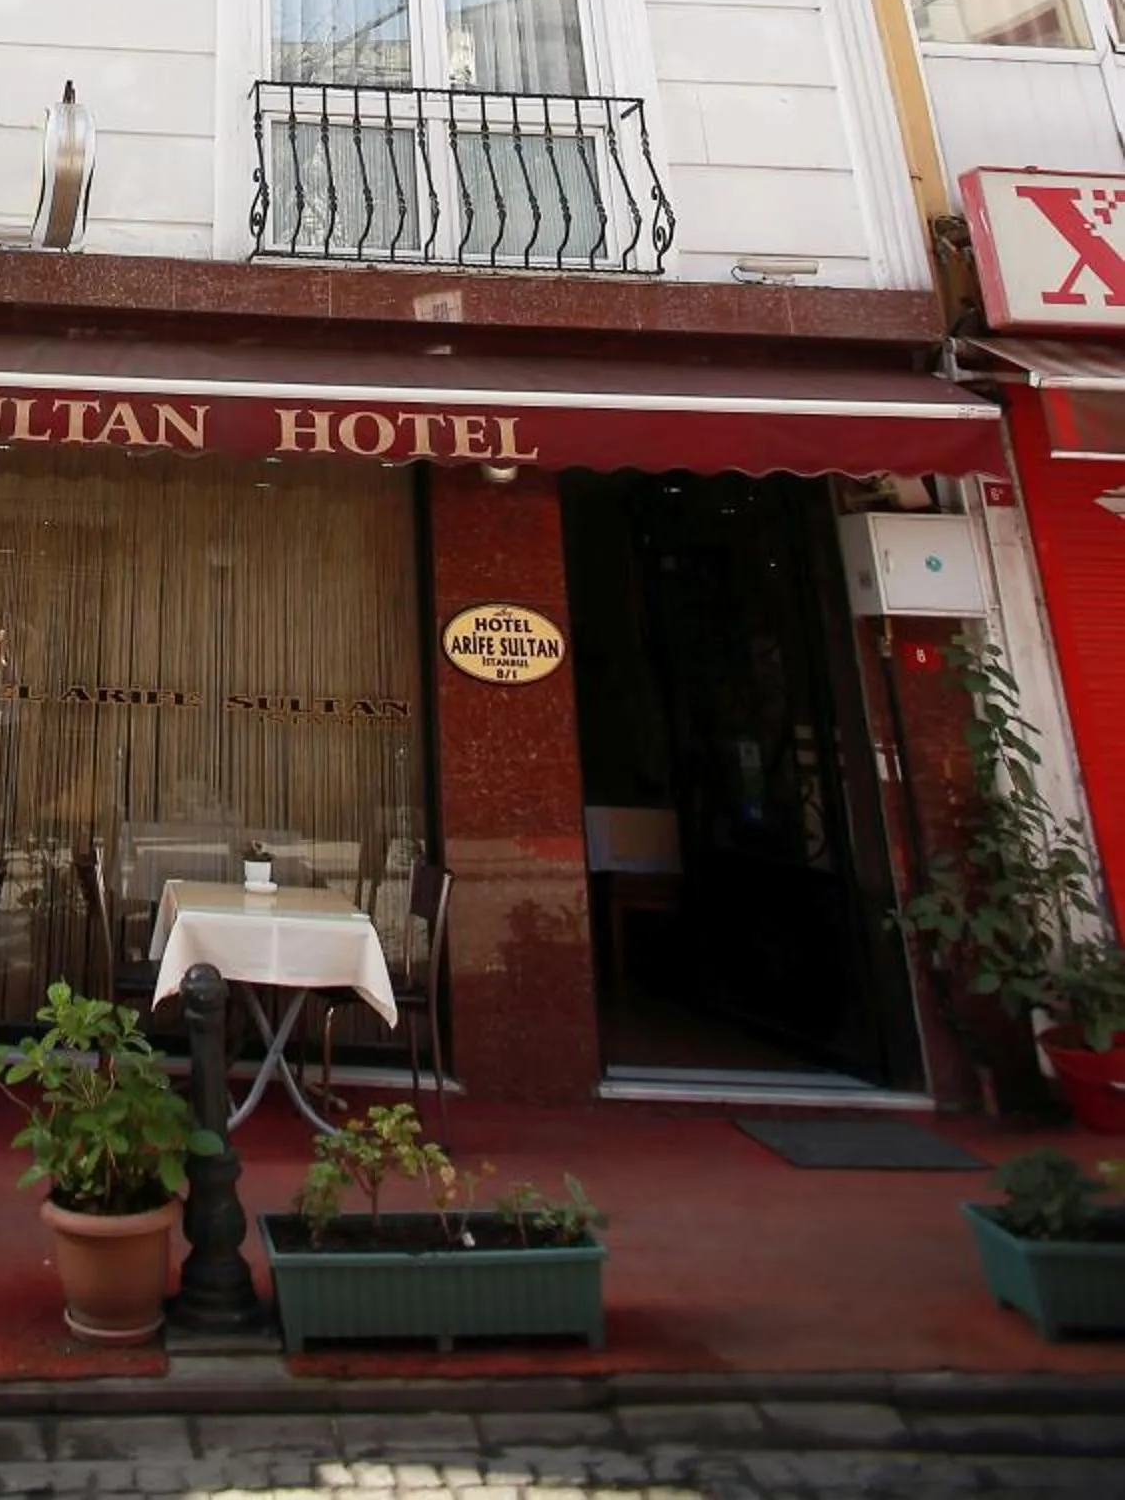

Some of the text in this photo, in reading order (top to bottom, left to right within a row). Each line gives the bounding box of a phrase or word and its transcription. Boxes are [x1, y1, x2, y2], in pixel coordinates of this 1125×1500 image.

[1014, 185, 1125, 307] X
[275, 408, 539, 460] HOTEL
[475, 617, 533, 633] HOTEL
[451, 632, 560, 658] ARİFE SULTAN
[226, 694, 411, 717] SULTAN
